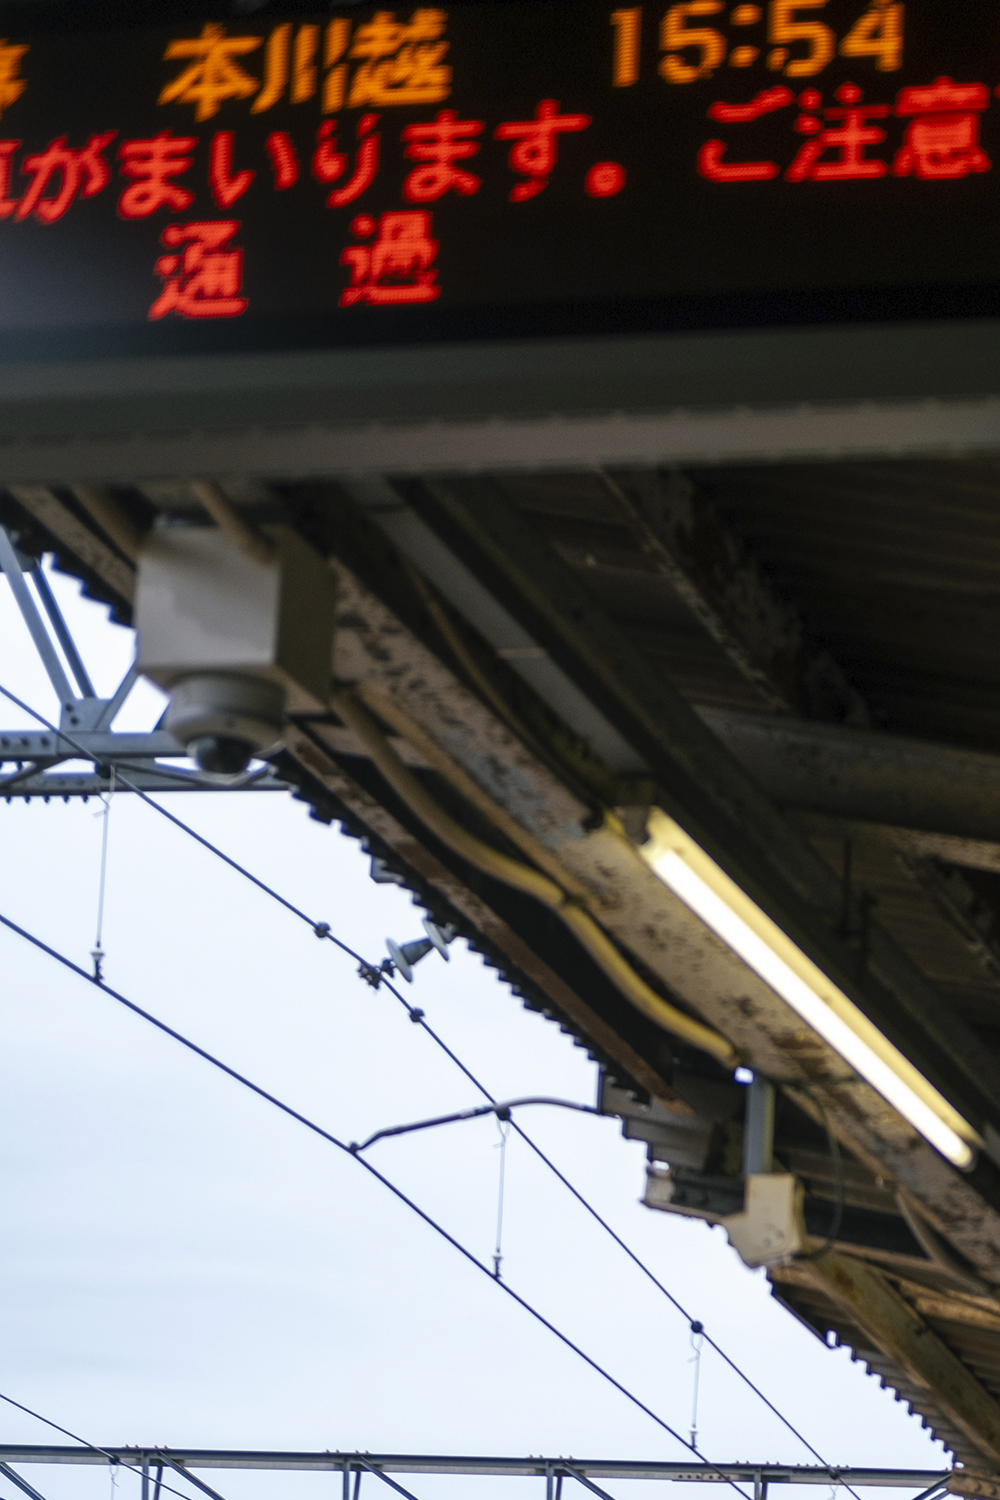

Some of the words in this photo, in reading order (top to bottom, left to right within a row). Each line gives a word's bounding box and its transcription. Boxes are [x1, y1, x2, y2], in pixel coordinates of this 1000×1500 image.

[157, 8, 453, 121] 本川越
[610, 0, 906, 87] 15:54
